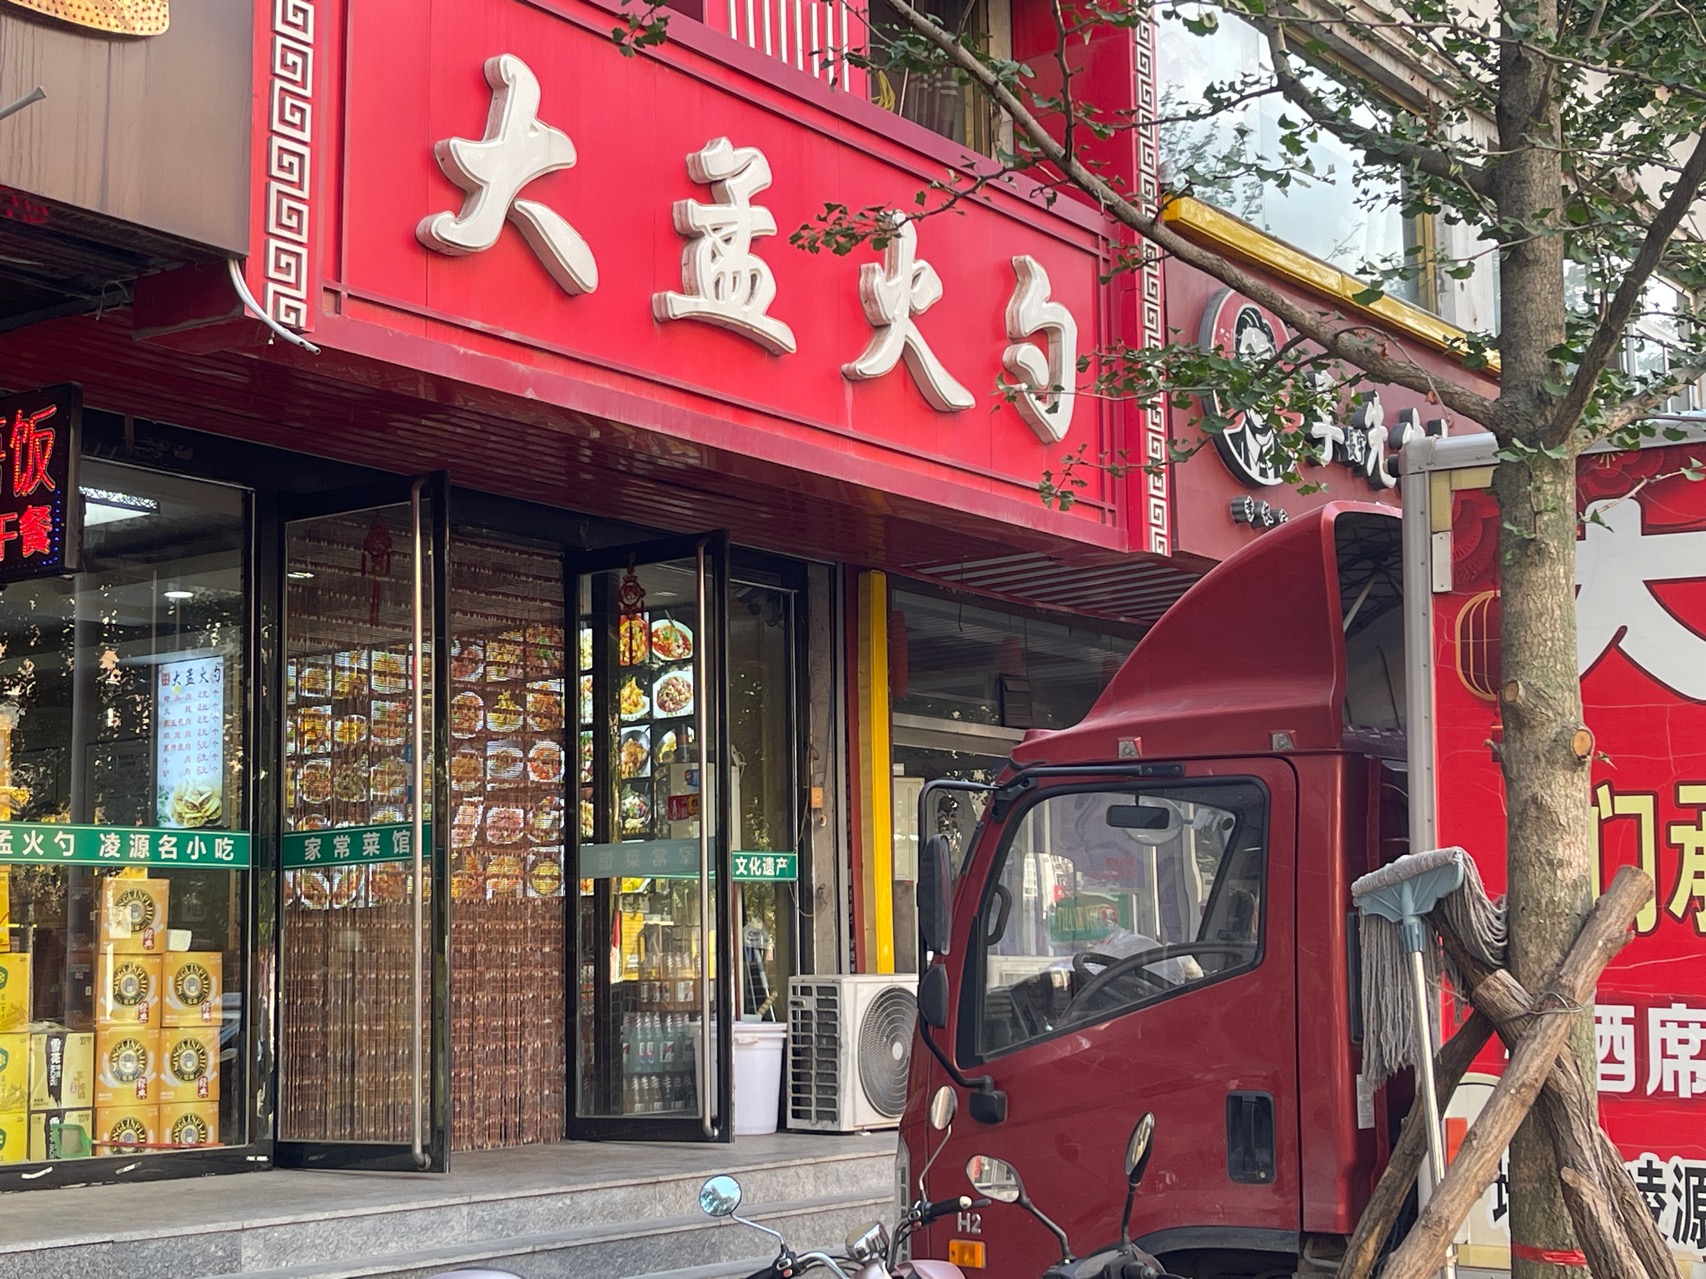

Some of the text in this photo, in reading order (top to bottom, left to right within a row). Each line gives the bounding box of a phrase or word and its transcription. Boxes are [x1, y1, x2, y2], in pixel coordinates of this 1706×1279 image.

[0, 404, 57, 498] 饭
[99, 833, 235, 861] 凌源名小吃
[304, 830, 411, 861] 家常菜馆
[735, 856, 788, 876] 文化遗产
[957, 1211, 982, 1234] H2
